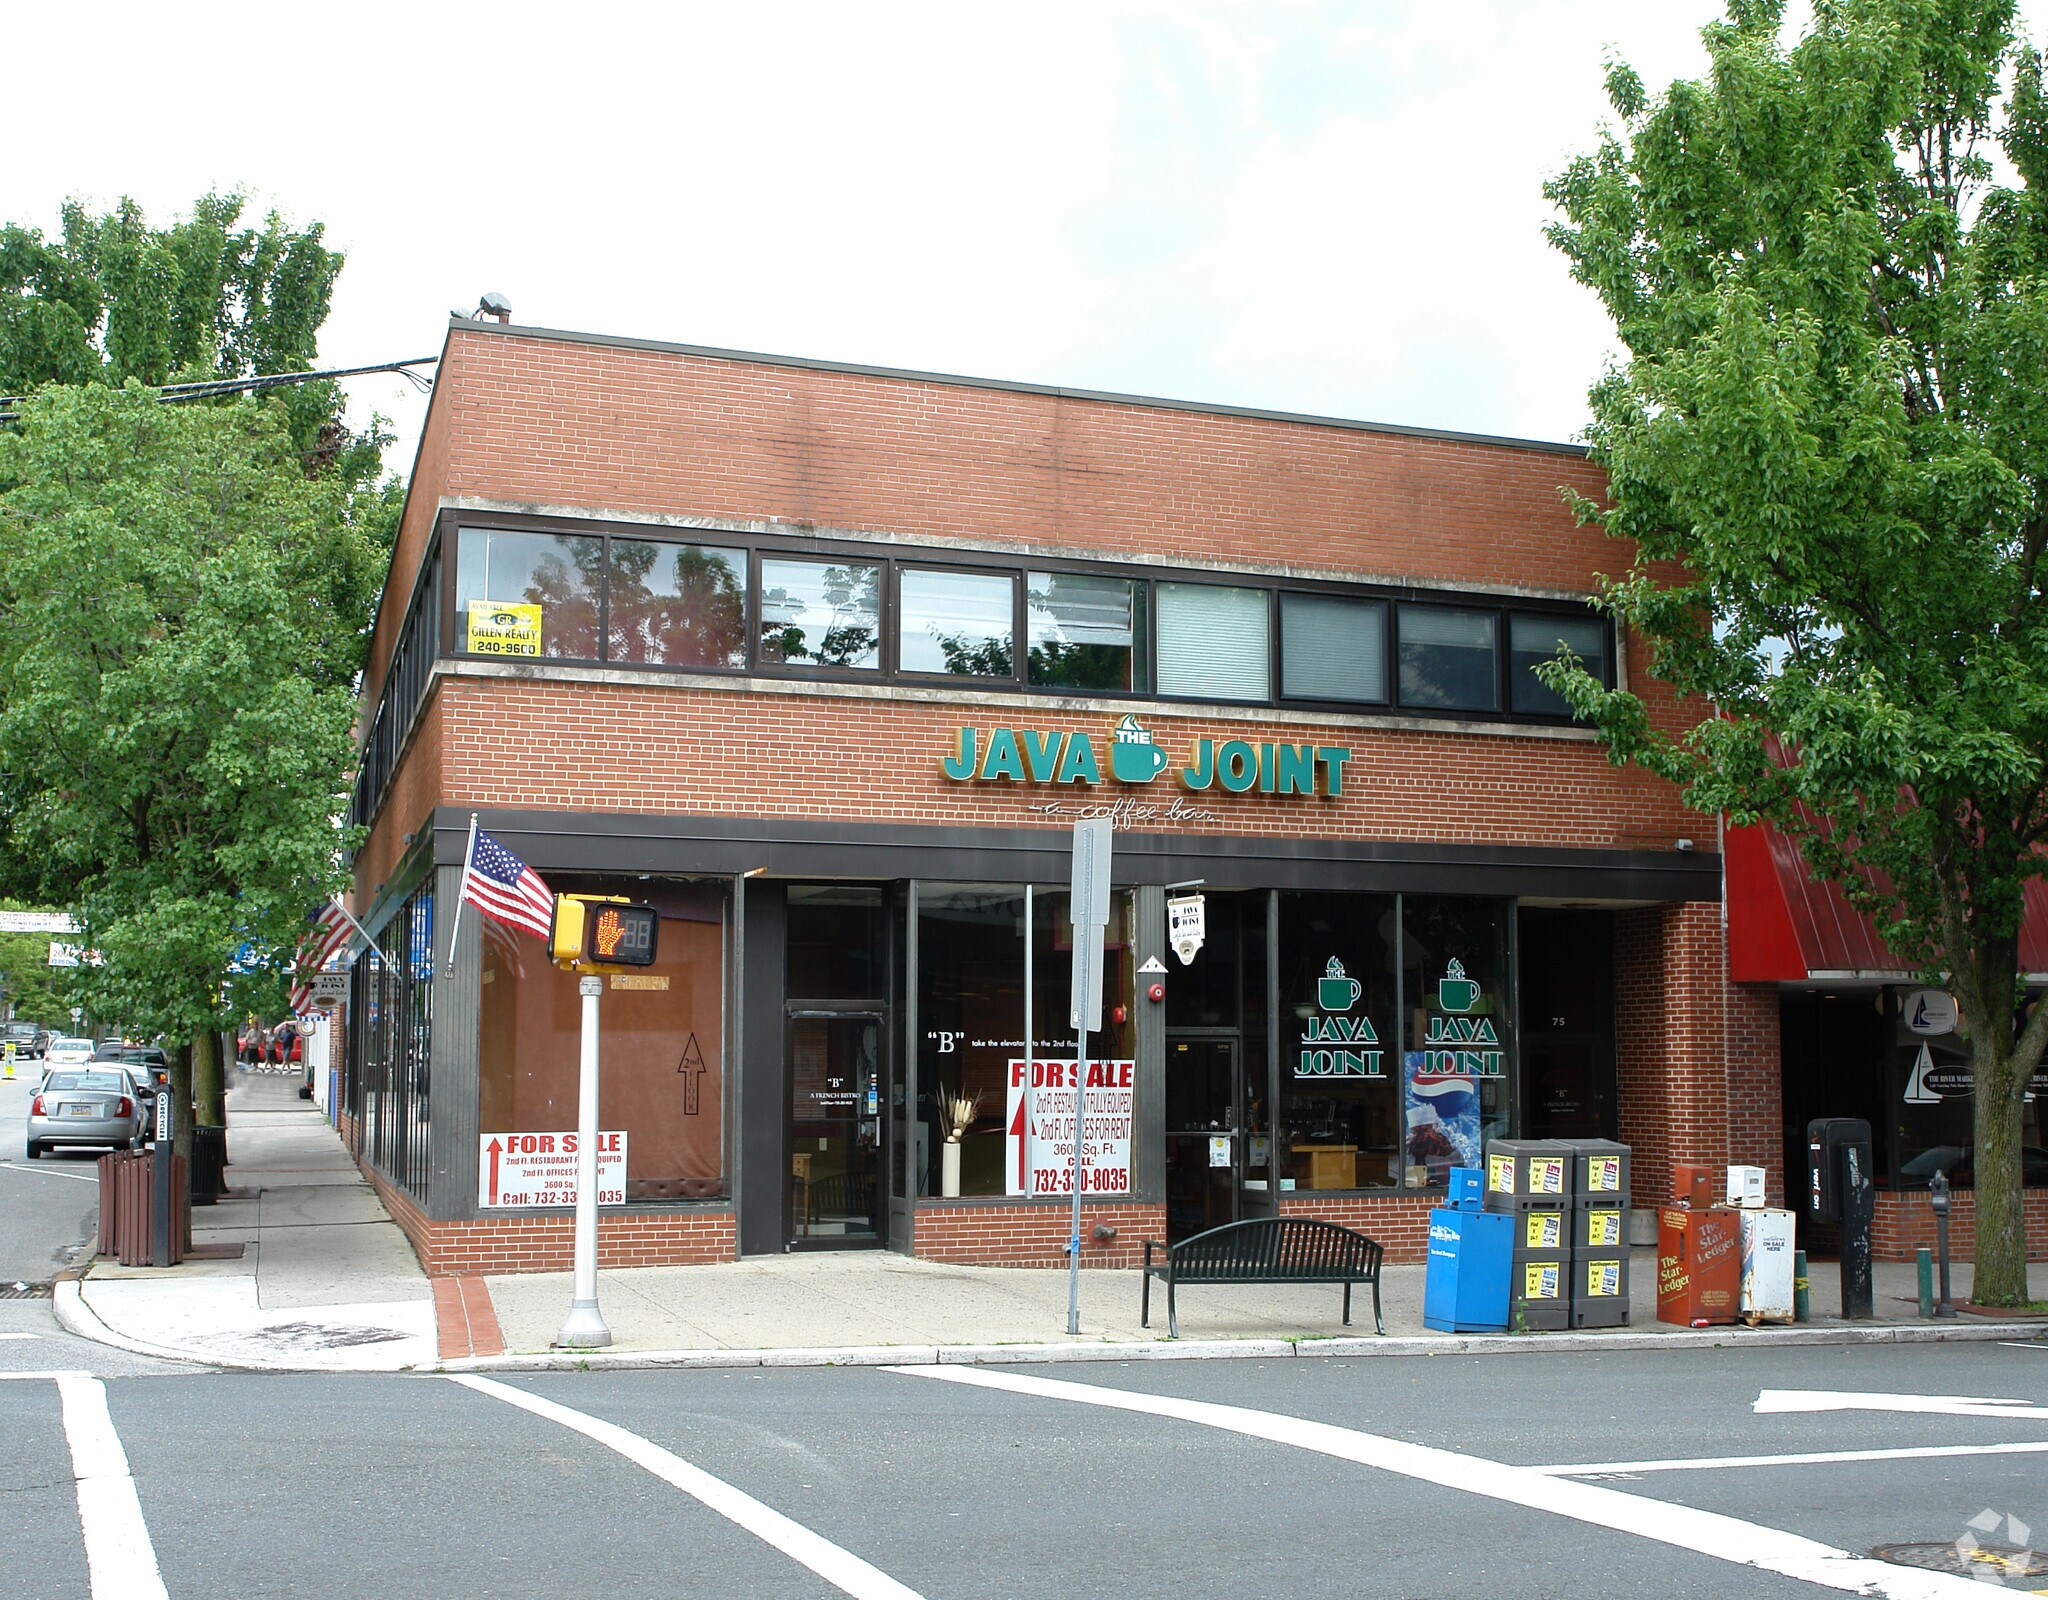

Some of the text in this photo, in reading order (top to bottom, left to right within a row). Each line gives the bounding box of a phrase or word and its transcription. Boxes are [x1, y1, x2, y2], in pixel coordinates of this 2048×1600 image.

[497, 615, 512, 625] GR
[472, 627, 537, 640] GILLEN REALTY
[477, 641, 536, 654] 240-9600
[1115, 730, 1151, 745] THE
[940, 727, 1352, 796] JAVA JOINT
[1079, 797, 1158, 831] coffee
[1165, 797, 1221, 822] bar
[1326, 969, 1346, 978] THE
[1447, 971, 1465, 980] THE
[1301, 1016, 1378, 1042] JAVA
[1552, 1017, 1565, 1026] 75
[1425, 1017, 1498, 1042] JAVA
[927, 1031, 965, 1053] "B"
[684, 1057, 699, 1068] 2nd
[1294, 1050, 1384, 1075] JOINT
[1418, 1050, 1504, 1075] JOINT
[1011, 1062, 1133, 1088] FOR SALE
[1036, 1093, 1046, 1114] 2nd
[1054, 1093, 1090, 1113] RESTAURNT
[1091, 1093, 1107, 1113] FULLY
[1108, 1093, 1131, 1113] EQUIPED
[1041, 1118, 1054, 1140] 2nd
[1064, 1118, 1094, 1140] OFFES
[1095, 1118, 1110, 1140] FOR
[1111, 1117, 1130, 1139] RENT
[508, 1134, 620, 1153] FOR SLE
[1082, 1143, 1100, 1157] Sq.
[1103, 1143, 1116, 1154] Ft.
[530, 1156, 573, 1165] RESTAURANT
[1068, 1157, 1094, 1166] CLL:
[546, 1169, 573, 1177] OFFICES
[544, 1181, 562, 1189] 3600
[503, 1190, 622, 1205] Call: 732-33035
[1699, 1221, 1720, 1236] The
[1700, 1231, 1727, 1250] Star-
[1696, 1237, 1735, 1264] Ledger
[1661, 1255, 1678, 1269] The
[1661, 1267, 1683, 1282] Star-
[1659, 1275, 1690, 1295] Ledger
